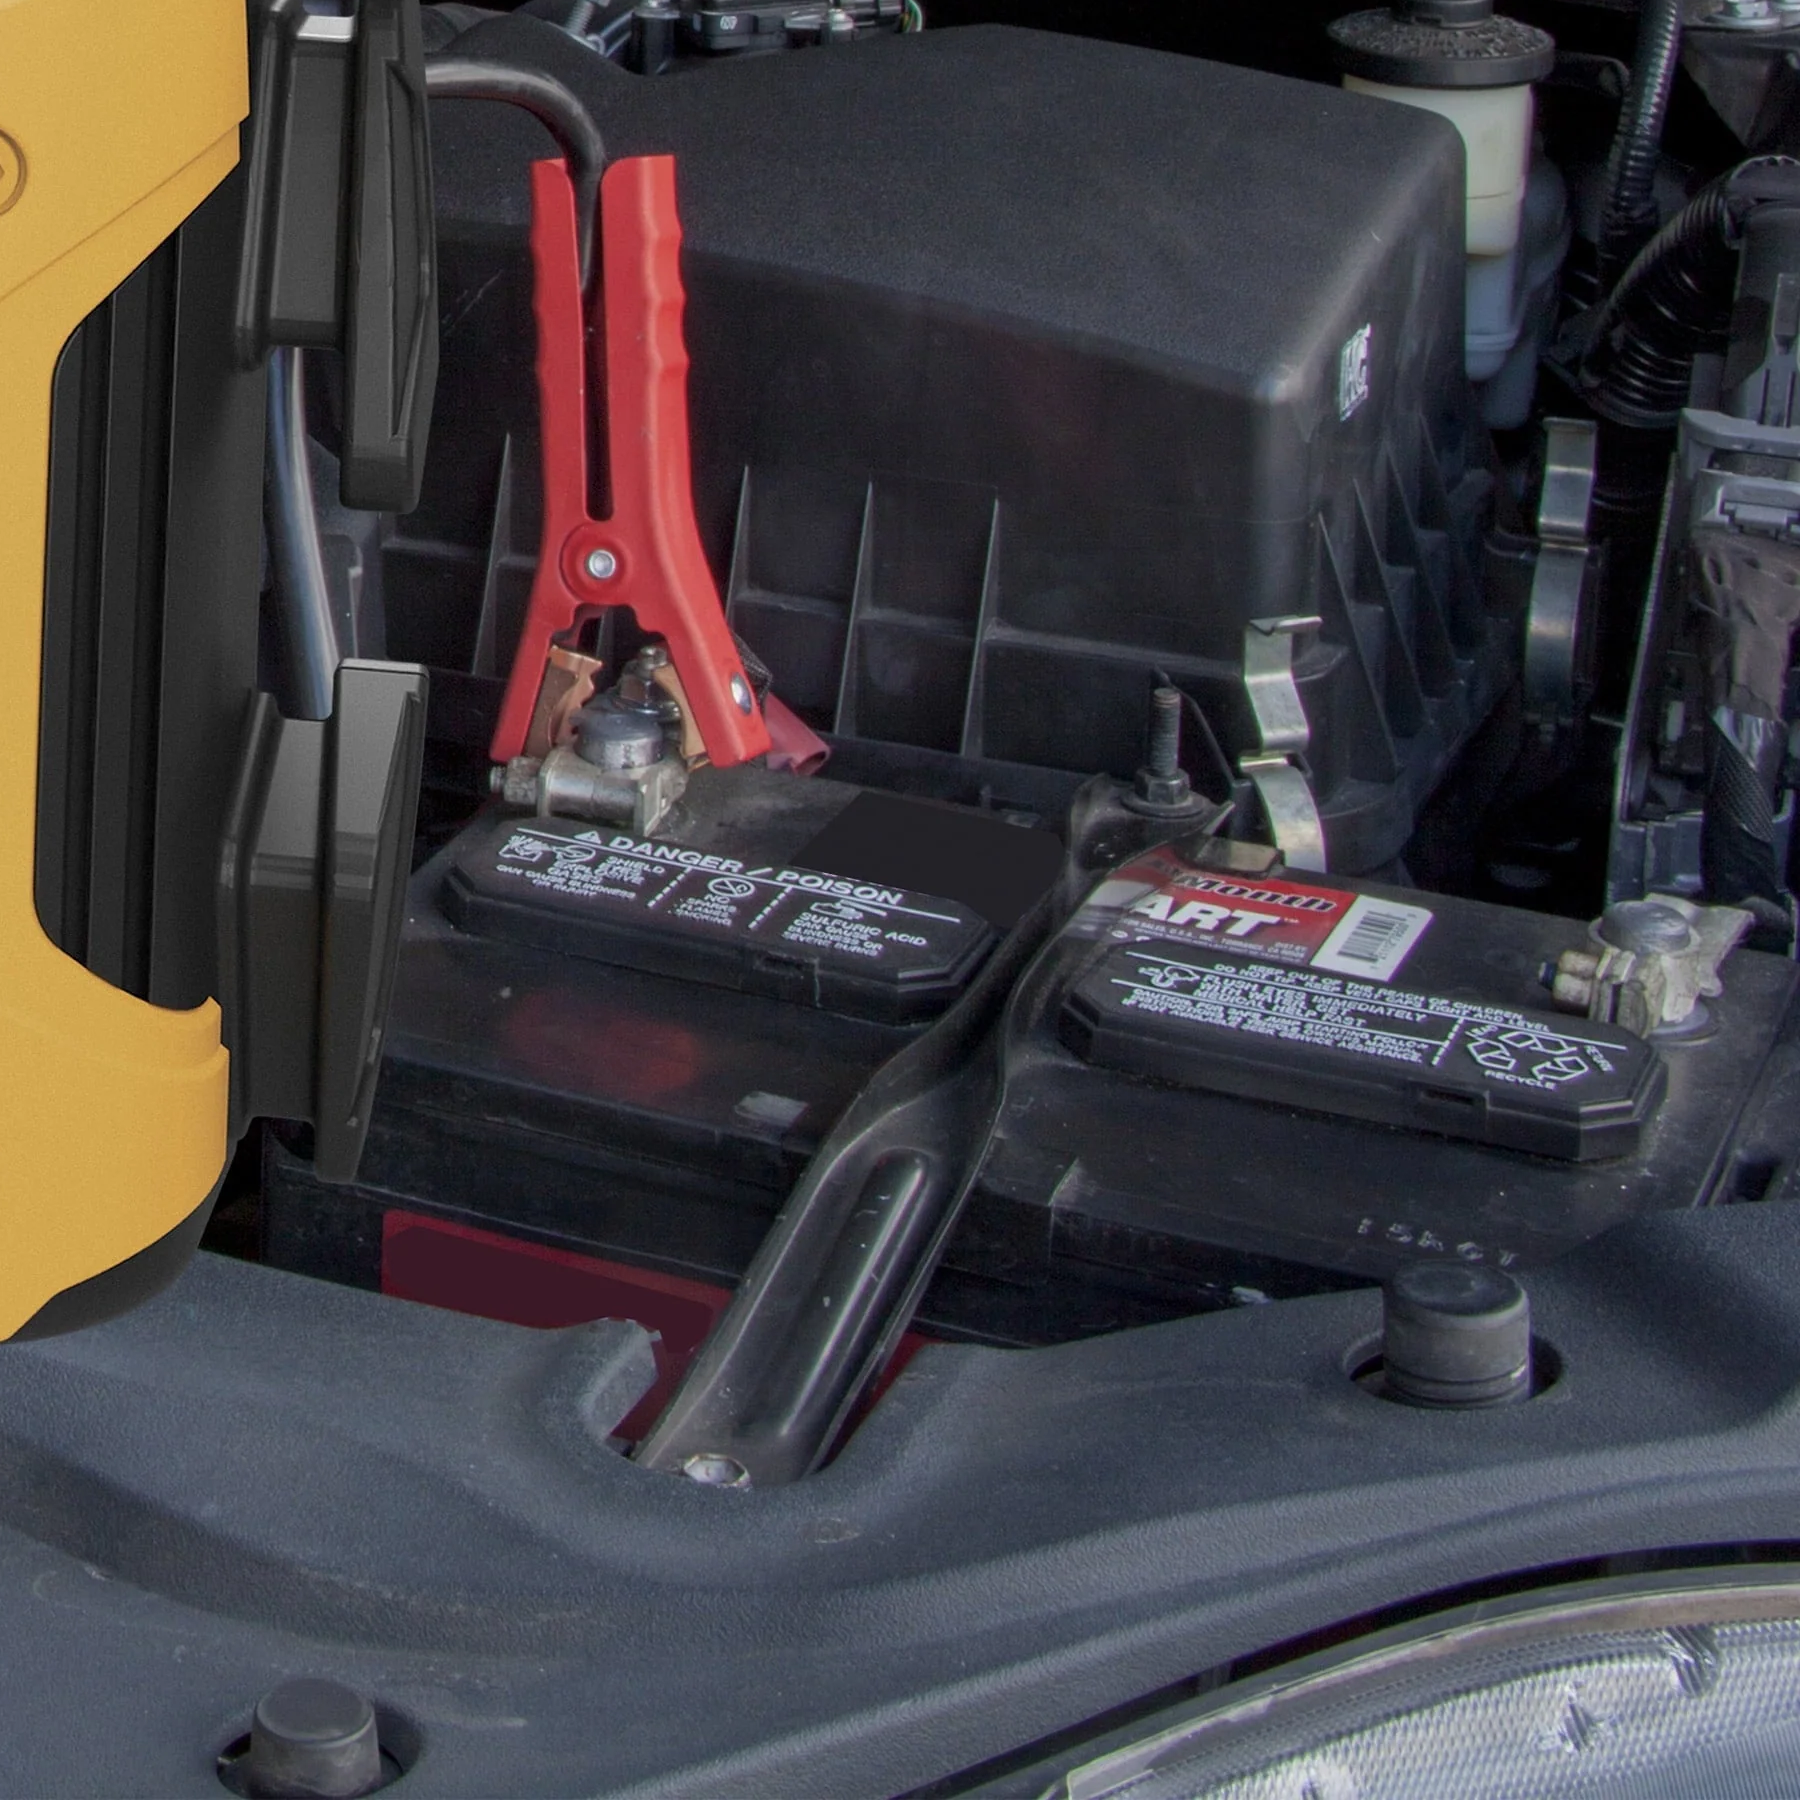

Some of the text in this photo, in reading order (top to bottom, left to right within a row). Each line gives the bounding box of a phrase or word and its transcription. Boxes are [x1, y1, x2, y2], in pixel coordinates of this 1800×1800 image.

[547, 867, 603, 884] GASES
[606, 856, 666, 875] SHIELD
[609, 835, 743, 877] DANGER
[775, 869, 904, 906] POISON
[703, 894, 730, 904] NO
[1174, 873, 1338, 914] Month
[787, 925, 884, 950] BLINDNESS OR
[793, 919, 871, 942] CAN CAUSE
[800, 912, 928, 947] SULFURIC ACID
[1199, 983, 1243, 998] WITH
[1314, 1003, 1350, 1017] GET
[1202, 974, 1428, 1023] FLUSH EYES IMMEDIATELY
[1213, 963, 1236, 974] DO
[1238, 970, 1273, 982] NOT
[1427, 1003, 1471, 1018] TIGHT
[1472, 1011, 1506, 1023] AND
[1508, 1016, 1551, 1033] LEVEL
[1248, 963, 1285, 977] KEEP
[1287, 971, 1318, 982] OUT
[1321, 977, 1343, 987] OF
[1378, 987, 1425, 1003] REACH
[1427, 996, 1450, 1006] OF
[1138, 1003, 1169, 1015] NOT
[1193, 989, 1368, 1029] MEDICAL HELP FAST
[1483, 1069, 1557, 1091] RECYCLE
